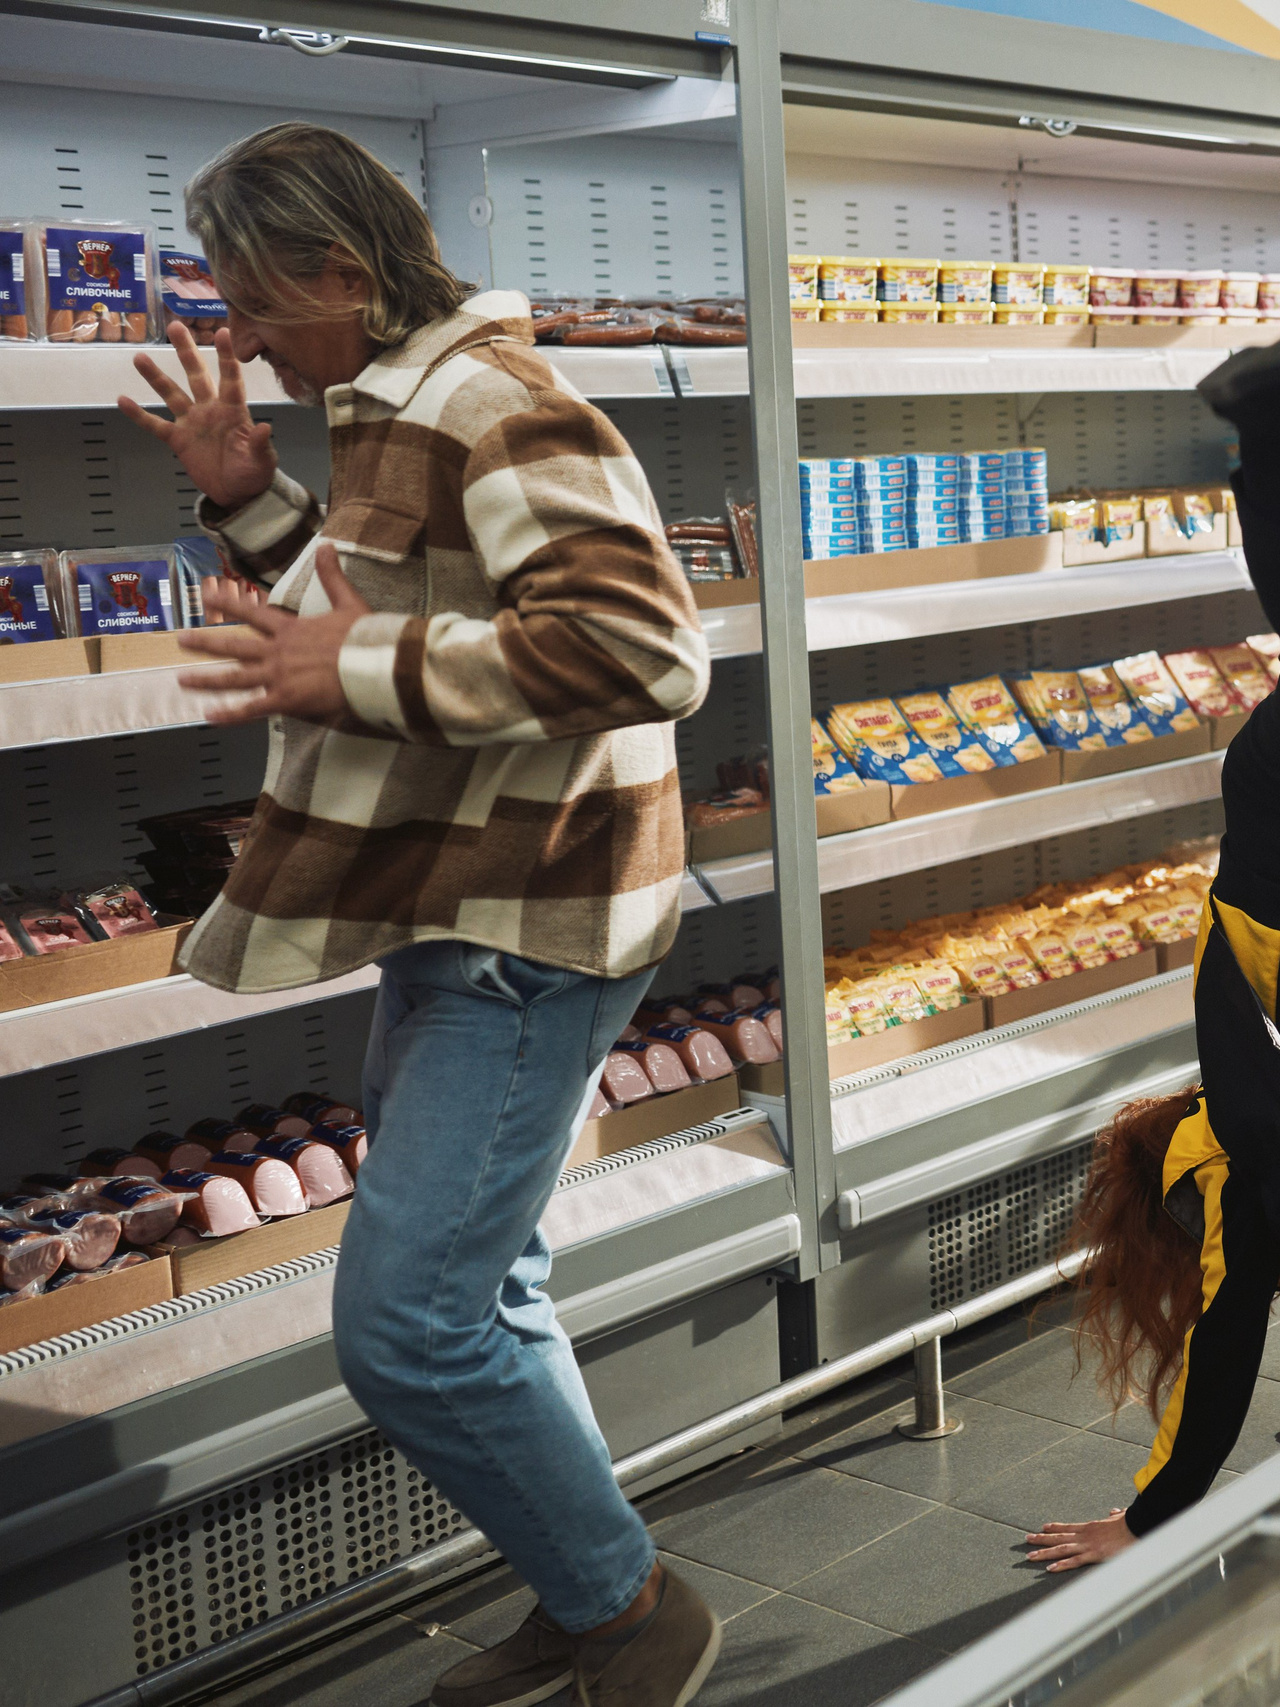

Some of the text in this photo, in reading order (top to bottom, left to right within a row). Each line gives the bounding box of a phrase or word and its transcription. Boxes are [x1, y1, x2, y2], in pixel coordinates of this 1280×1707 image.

[82, 242, 110, 252] ВЕРНЕР
[66, 287, 132, 299] СЛИВОЧНЫЕ
[111, 573, 138, 583] ВЕРНЕР
[97, 615, 160, 628] СЛИВОЧНЫЕ
